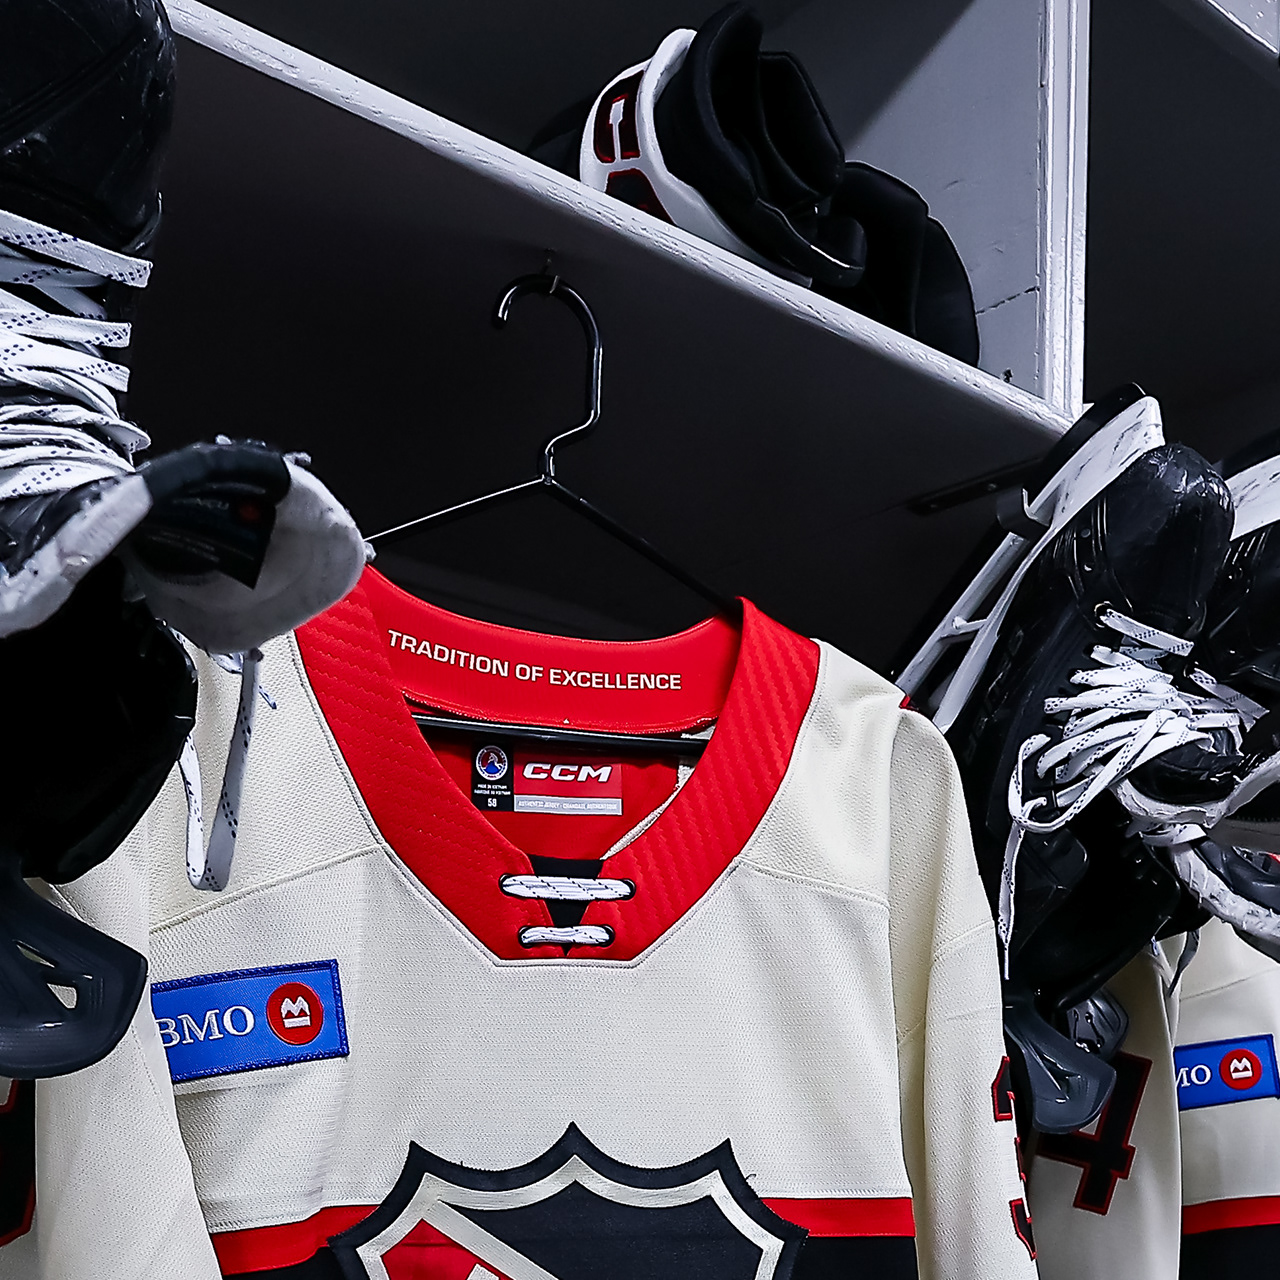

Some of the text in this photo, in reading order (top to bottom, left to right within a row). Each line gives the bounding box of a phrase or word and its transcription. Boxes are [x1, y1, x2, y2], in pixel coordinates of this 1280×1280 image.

[388, 629, 682, 690] TRADITION OF EXCELLENCE
[522, 762, 613, 783] CCM
[155, 1005, 255, 1047] BMO
[1035, 1051, 1153, 1217] 4
